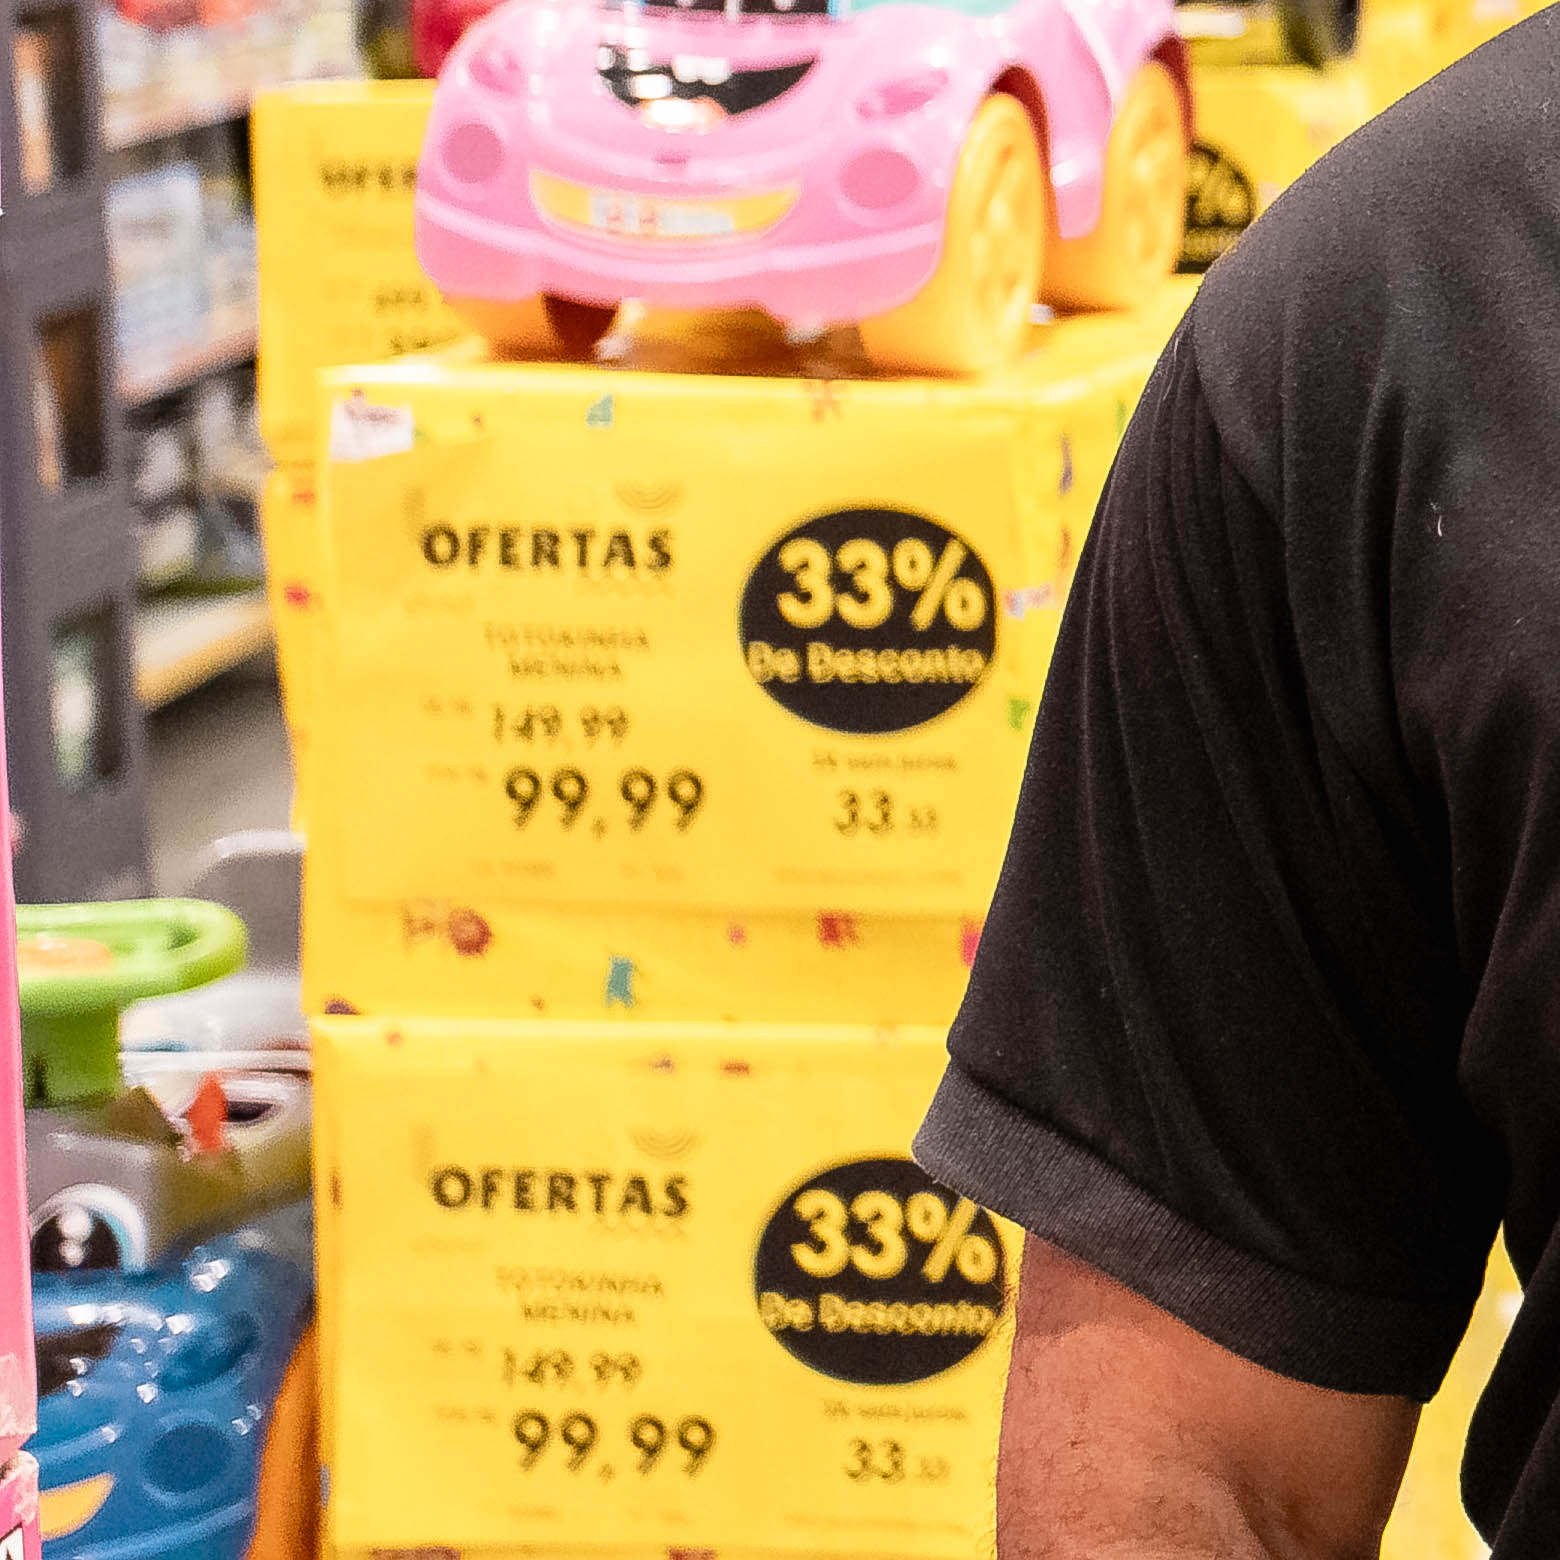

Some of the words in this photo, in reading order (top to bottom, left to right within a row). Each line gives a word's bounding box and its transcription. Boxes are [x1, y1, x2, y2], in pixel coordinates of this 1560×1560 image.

[421, 523, 675, 571] OFERTAS
[777, 537, 986, 632] 33%
[750, 641, 800, 683] De
[805, 641, 986, 684] Desconto
[431, 1165, 688, 1218] OFERTAS
[790, 1188, 997, 1285] 33%
[818, 1291, 997, 1337] Desconto
